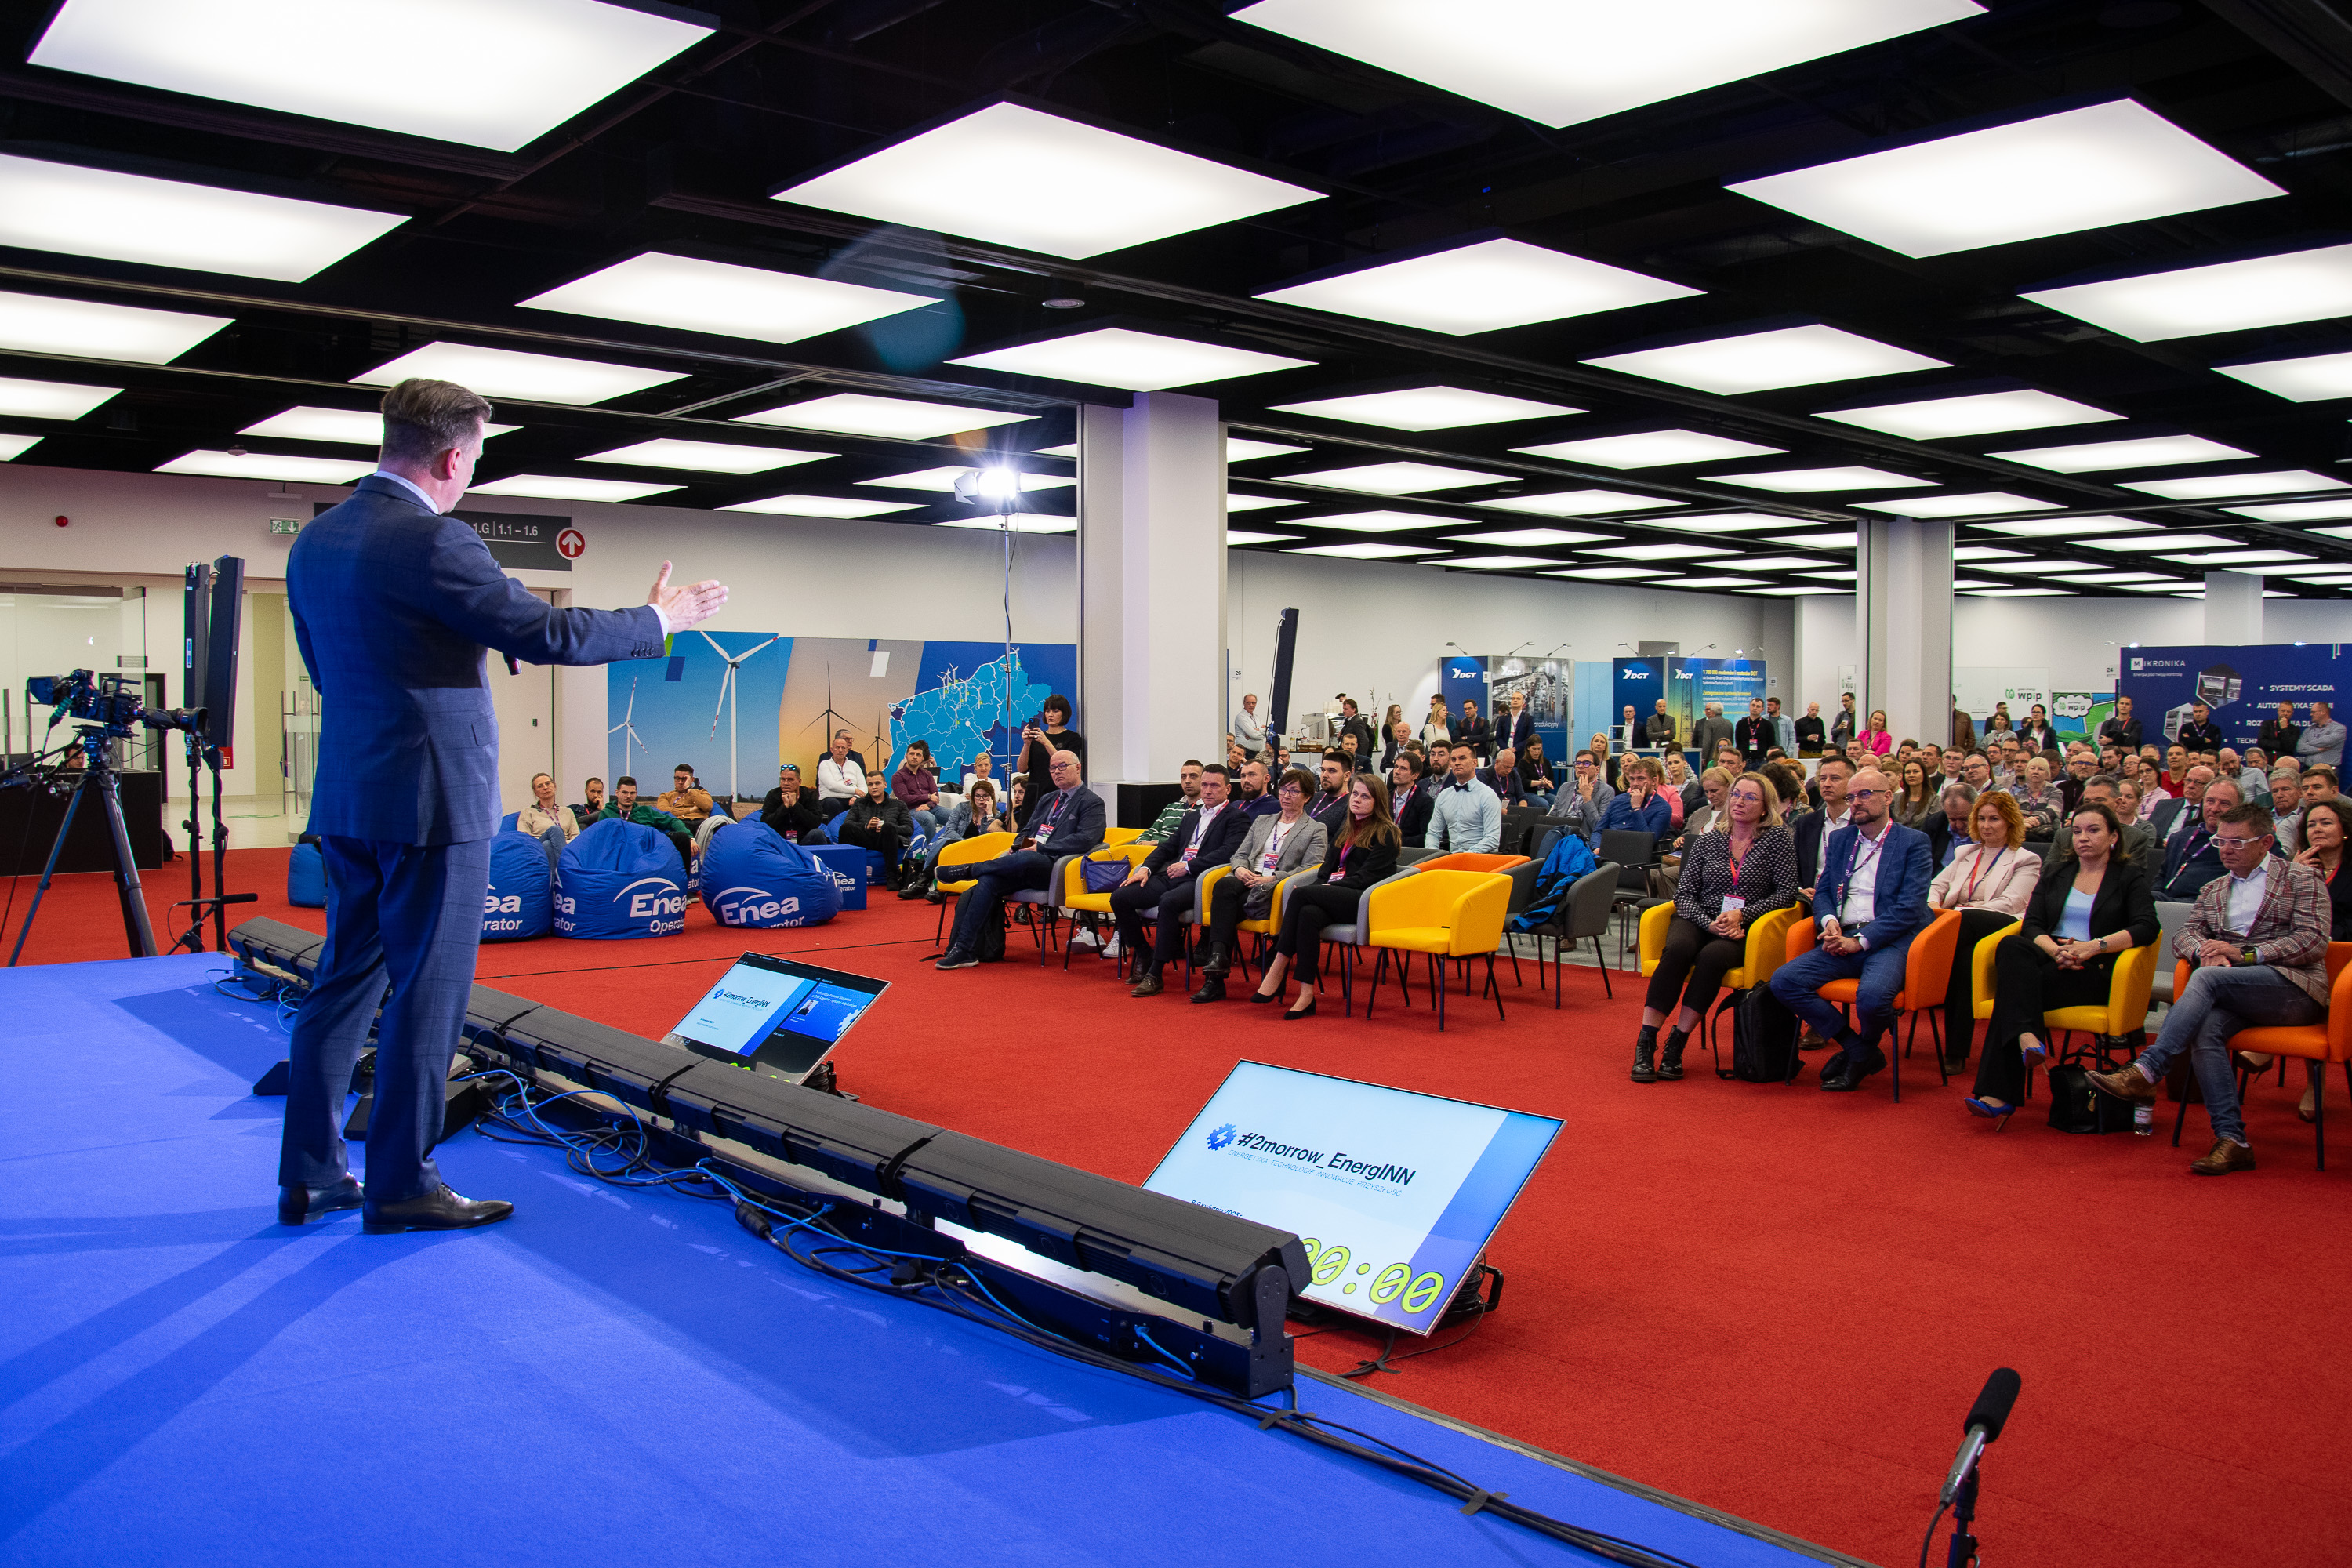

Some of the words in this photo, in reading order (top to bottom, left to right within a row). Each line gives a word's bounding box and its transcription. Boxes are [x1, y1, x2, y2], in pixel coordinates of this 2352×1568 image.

[499, 524, 512, 535] 1.1
[524, 525, 539, 536] 1.6
[2017, 692, 2042, 702] wpip
[630, 893, 688, 918] Enea
[721, 896, 800, 925] Enea
[1228, 1149, 1269, 1163] ENERGETYKA
[1270, 1160, 1316, 1175] TECHNOLOGIE
[1316, 1171, 1356, 1185] INNOWACJE
[1237, 1132, 1417, 1185] #2morrow_EnergINN
